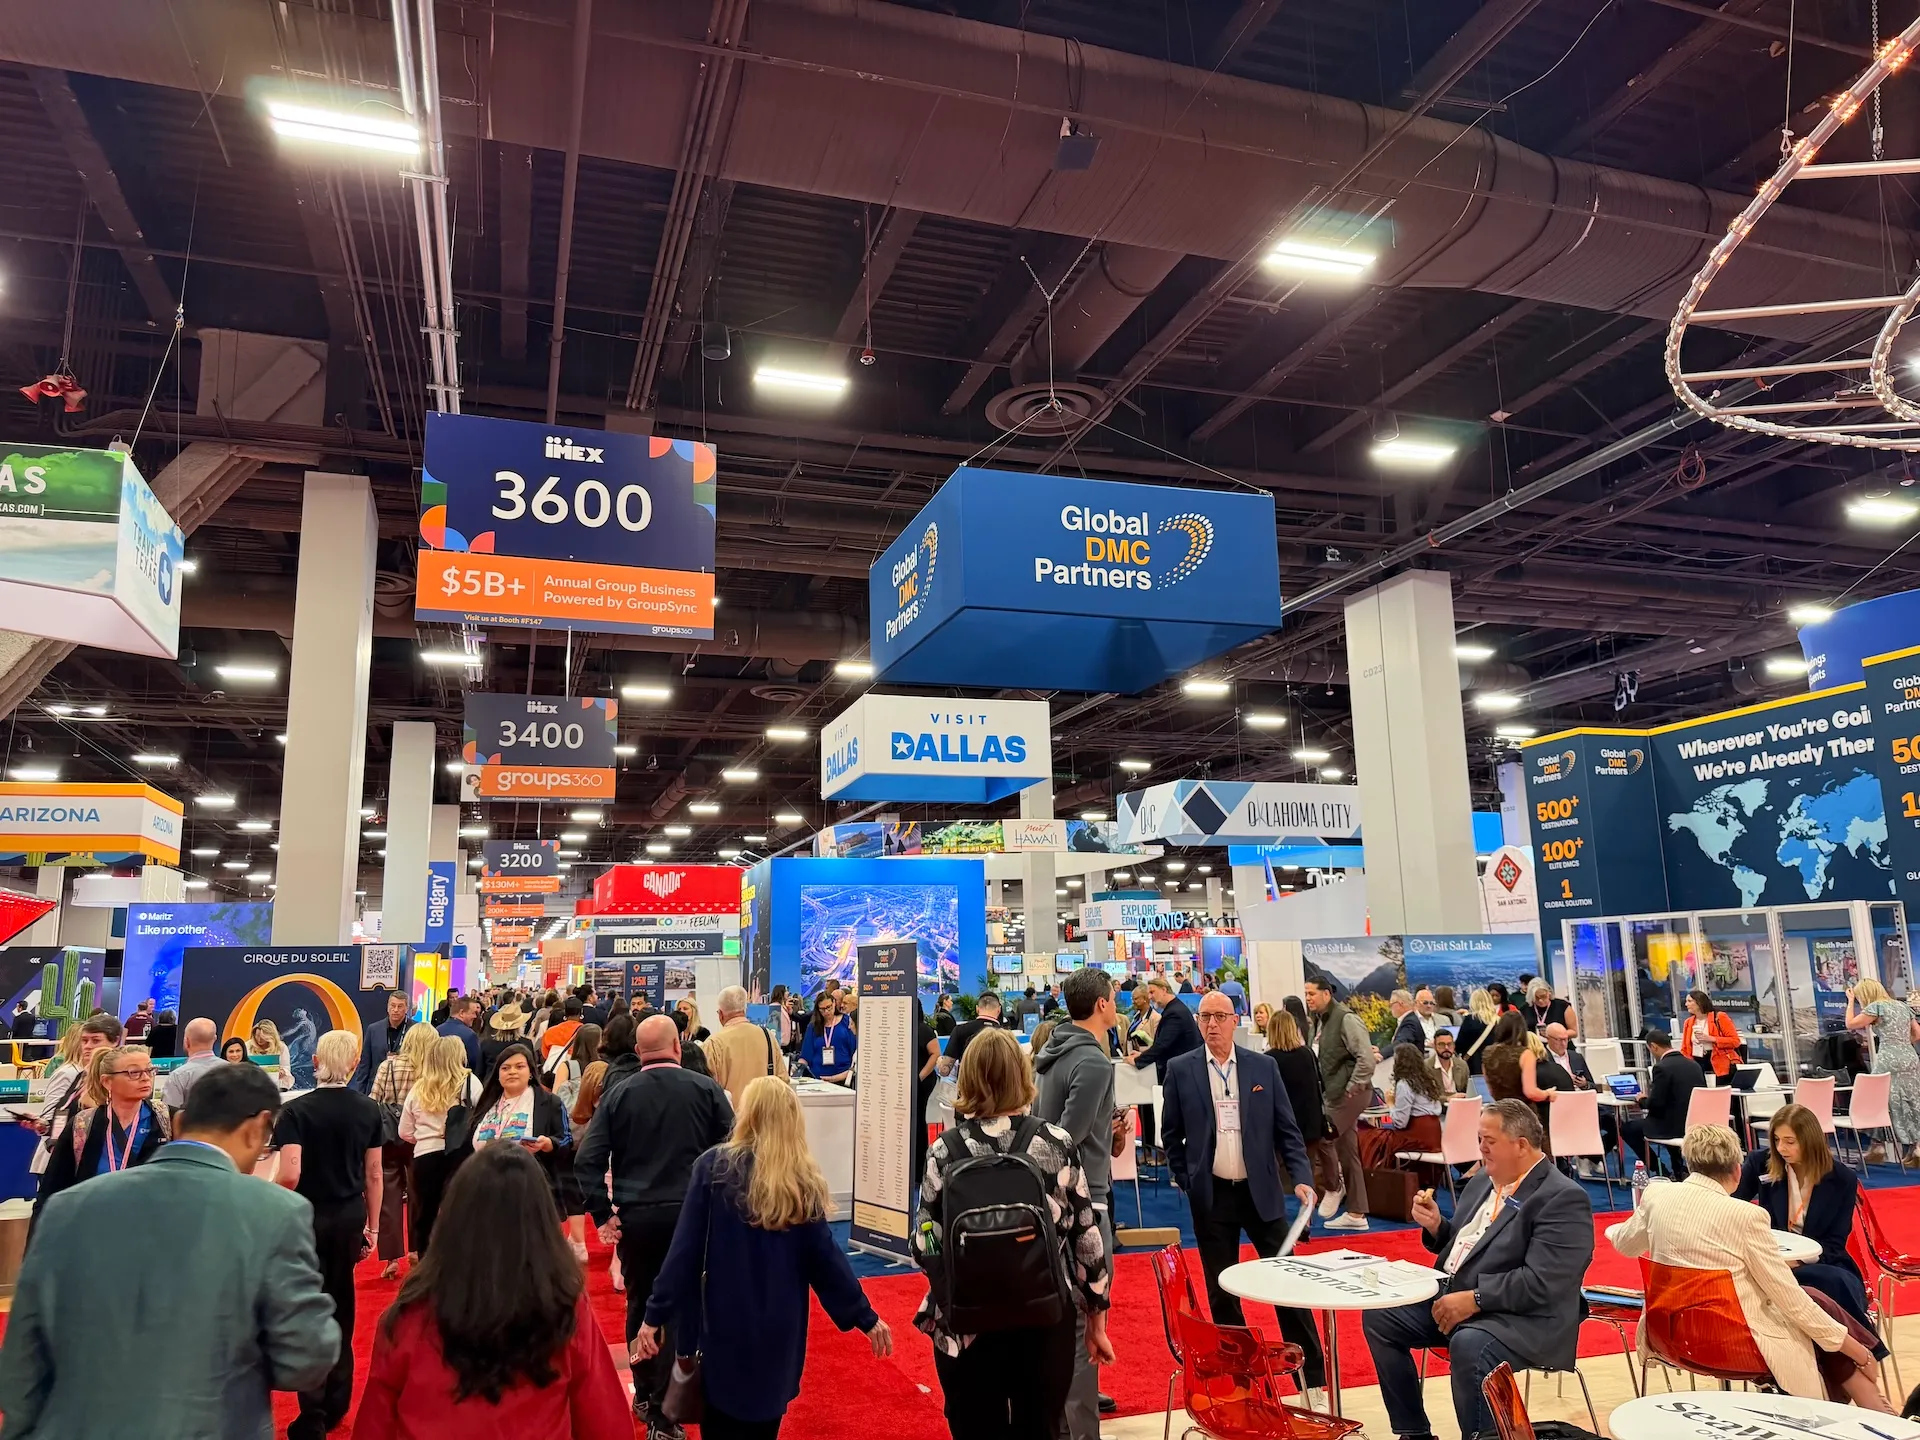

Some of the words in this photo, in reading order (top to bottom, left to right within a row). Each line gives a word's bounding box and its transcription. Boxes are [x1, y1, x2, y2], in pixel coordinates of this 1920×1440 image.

[491, 470, 652, 532] 3600
[1060, 504, 1149, 536] Global
[1085, 536, 1151, 566] DMC
[135, 546, 157, 586] TEXAS
[891, 543, 918, 588] Global
[1034, 557, 1152, 591] Partners
[441, 565, 525, 597] $5B+
[543, 574, 592, 590] Annual
[596, 578, 637, 594] Group
[640, 583, 696, 597] Business
[898, 573, 919, 608] DMC
[543, 591, 605, 607] Powered
[607, 595, 624, 611] by
[626, 599, 698, 617] GroupSync
[499, 616, 520, 624] Booth
[885, 598, 919, 643] Partners
[652, 625, 693, 636] groups360
[930, 713, 987, 725] VISIT
[498, 720, 584, 749] 3400
[834, 723, 848, 741] VISIT
[1678, 730, 1764, 760] Wherever
[1766, 716, 1829, 742] You're
[891, 731, 1027, 763] DALLAS
[1600, 748, 1626, 759] Global
[826, 736, 859, 784] DALLAS
[1537, 754, 1560, 767] Global
[1543, 763, 1561, 775] DMC
[1607, 758, 1627, 768] DMC
[1693, 759, 1746, 782] We're
[1749, 743, 1824, 773] Already
[497, 770, 602, 791] groups360
[1532, 772, 1562, 785] Partners
[1595, 765, 1628, 776] Partners
[0, 807, 100, 822] ARIZONA
[1247, 797, 1318, 828] OKLAHOMA
[1322, 803, 1352, 829] CITY
[1536, 795, 1580, 822] 500+
[152, 815, 173, 834] ARIZONA
[1541, 817, 1579, 830] DESTINATIONS
[1542, 836, 1584, 862] 100+
[500, 853, 543, 868] 3200
[1548, 861, 1562, 870] ELITE
[485, 880, 520, 890] $130M+
[643, 871, 682, 899] CANADA
[1561, 879, 1573, 898] 1
[427, 874, 449, 928] Calgary
[1544, 900, 1565, 909] GLOBAL
[1565, 898, 1593, 907] SOLUTION
[148, 912, 173, 920] Maritz
[1136, 911, 1184, 933] TORONTO
[138, 925, 161, 935] Like
[161, 926, 177, 935] no
[177, 925, 207, 935] other
[613, 938, 657, 954] HERSHEY
[659, 940, 706, 949] RESORTS
[1314, 945, 1327, 953] Visit
[1328, 944, 1340, 953] Salt
[1340, 944, 1356, 953] Lake
[1426, 941, 1448, 951] Visit
[1450, 941, 1470, 951] Salt
[1470, 940, 1492, 950] Lake
[243, 953, 289, 965] CIRQUE
[291, 954, 308, 963] DU
[310, 953, 350, 963] SOLEIL
[1259, 1258, 1381, 1298] Freeman
